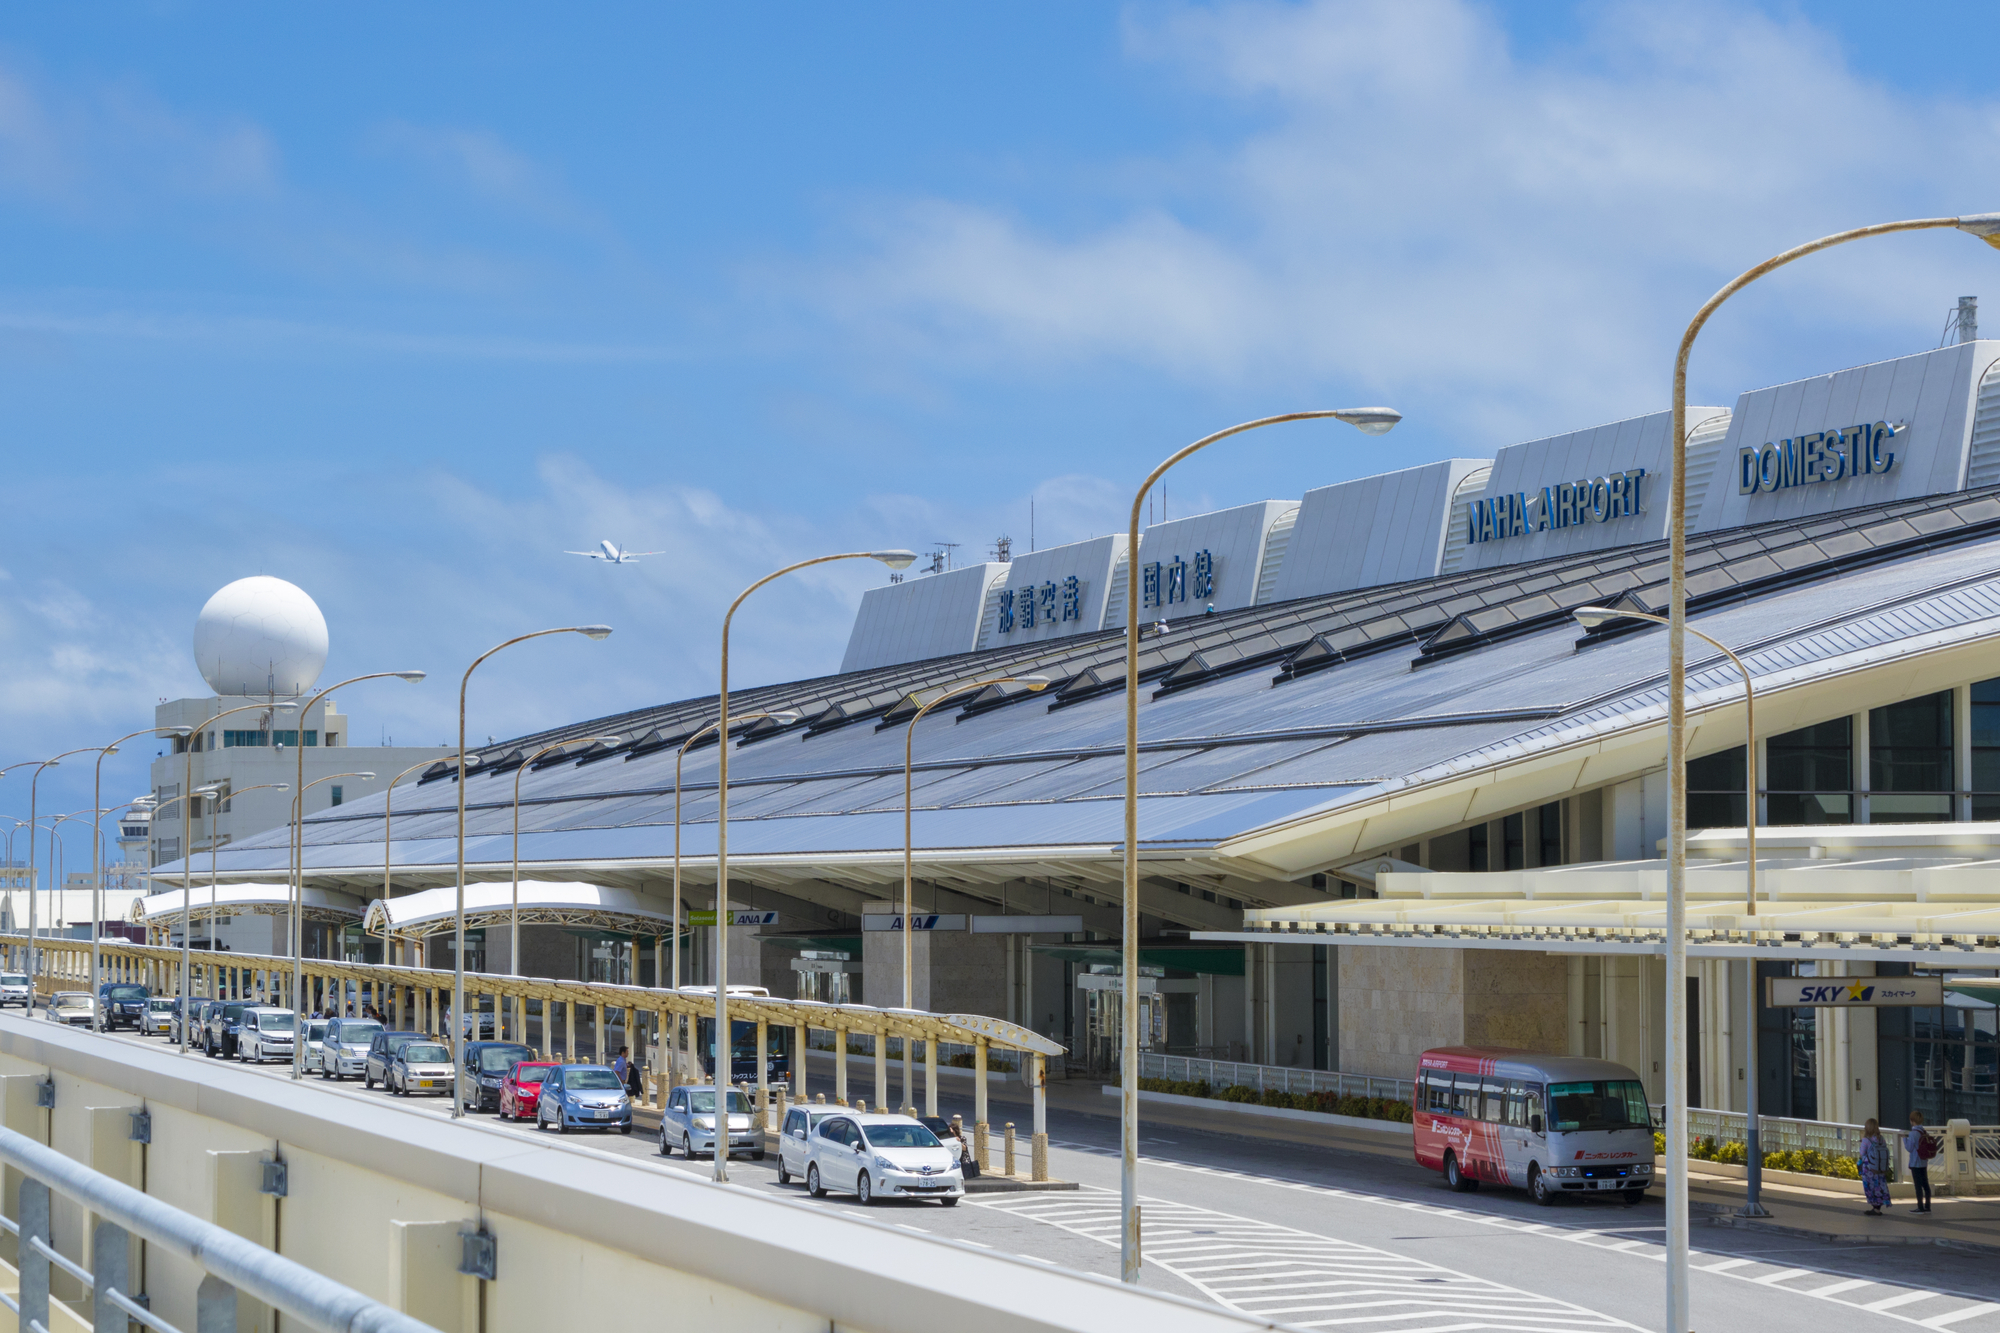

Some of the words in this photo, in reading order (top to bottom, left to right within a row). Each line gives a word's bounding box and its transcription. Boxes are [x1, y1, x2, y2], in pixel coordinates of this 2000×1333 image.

[1739, 421, 1894, 495] DOMESTIC
[1466, 492, 1530, 544] NAHA
[1536, 468, 1645, 532] AIRPORT
[998, 575, 1078, 633] 那覇空港
[1143, 549, 1212, 608] 国内線
[737, 914, 760, 924] ANA
[1798, 986, 1845, 1002] SKY
[1881, 990, 1916, 998] スカイマーク
